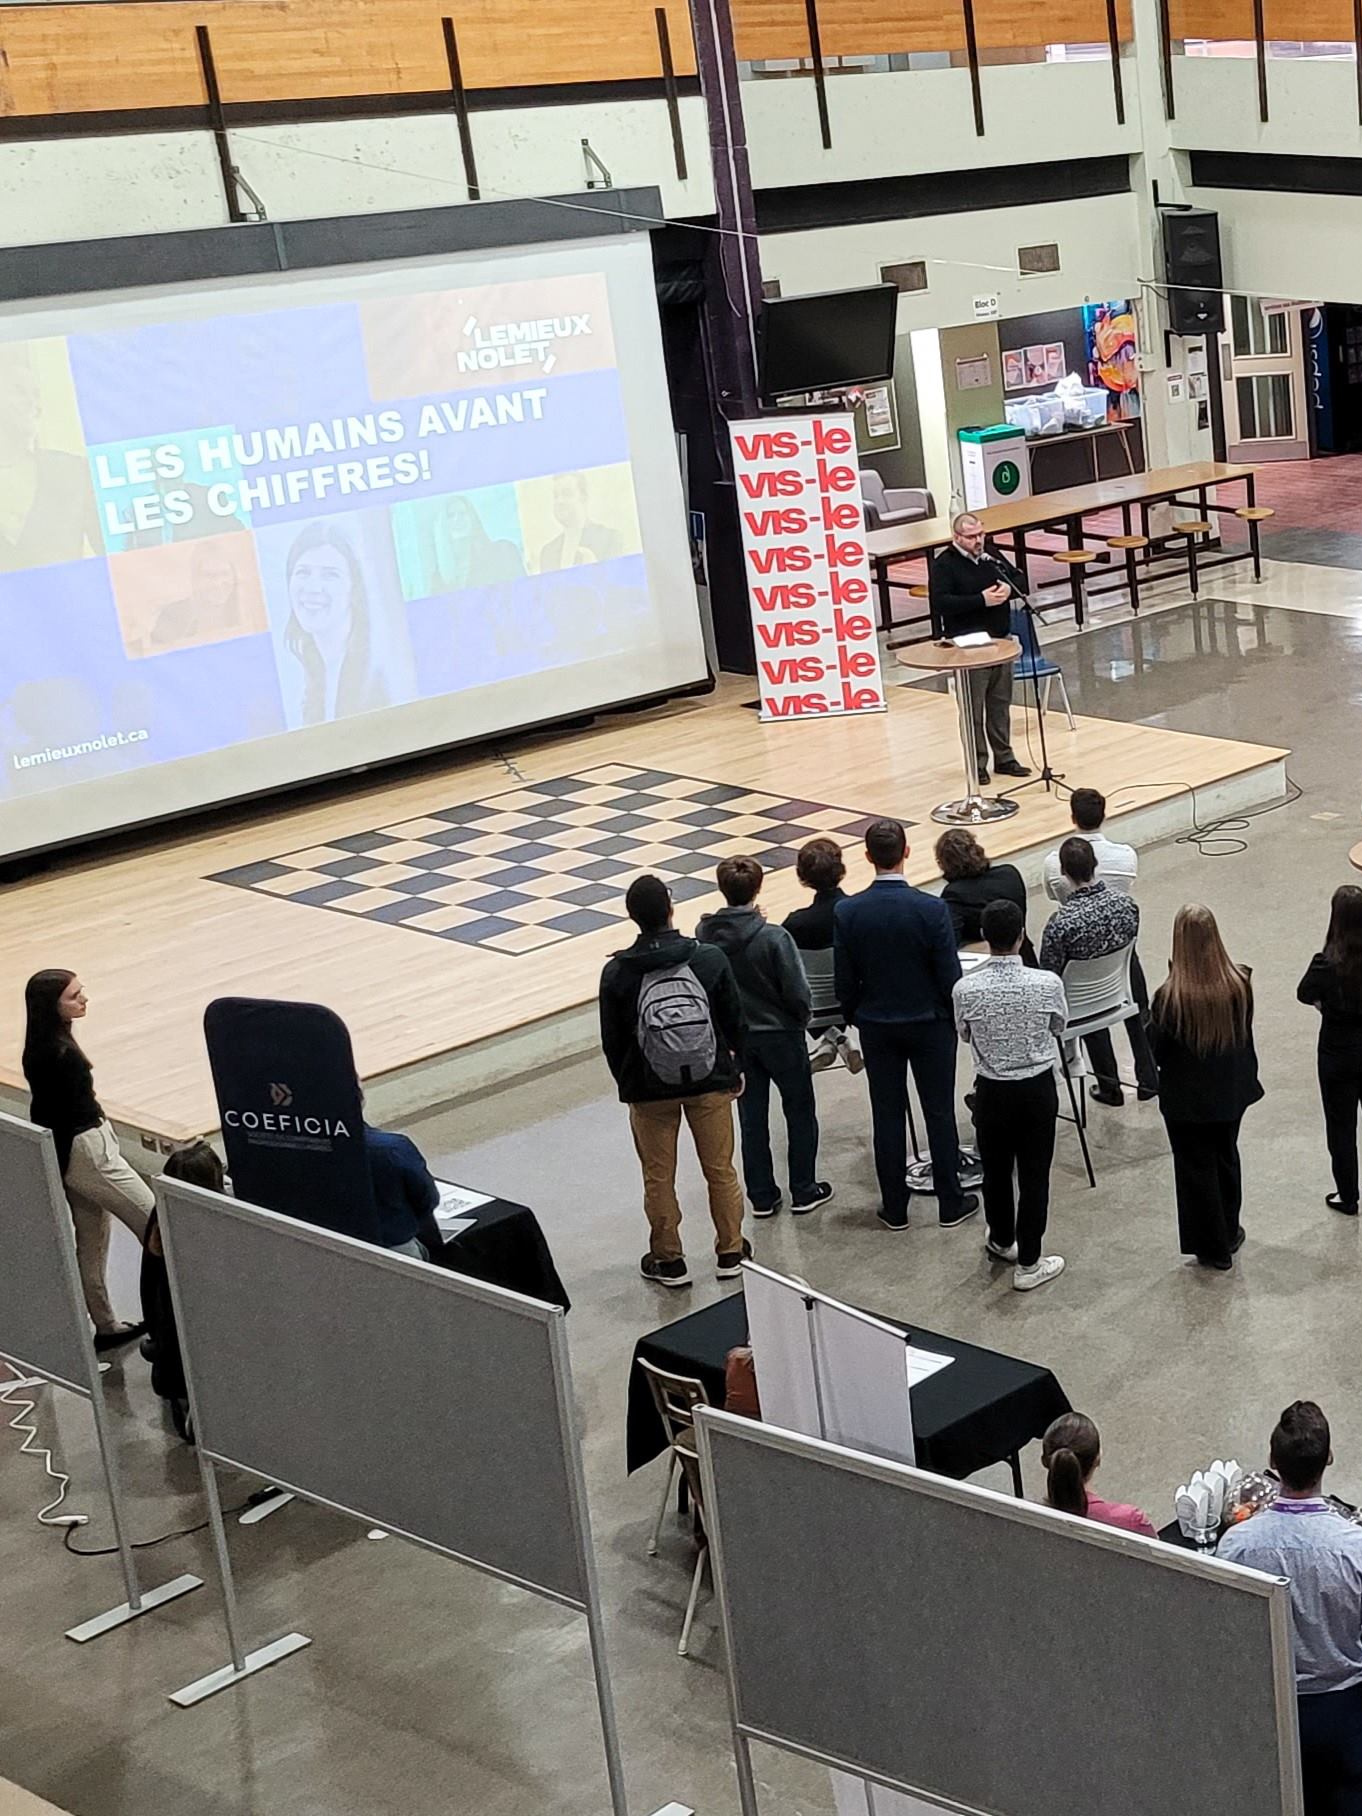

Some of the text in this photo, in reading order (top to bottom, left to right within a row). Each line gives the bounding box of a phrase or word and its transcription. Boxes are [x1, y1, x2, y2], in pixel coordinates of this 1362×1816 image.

[473, 313, 593, 349] LEMIEUX
[456, 340, 551, 373] NOLET
[96, 388, 548, 489] LES HUMAINS AVANT
[104, 450, 433, 535] LES CHIFFRES!
[13, 729, 149, 770] lemieuxnolet.ca
[224, 1110, 350, 1138] COEFICIA
